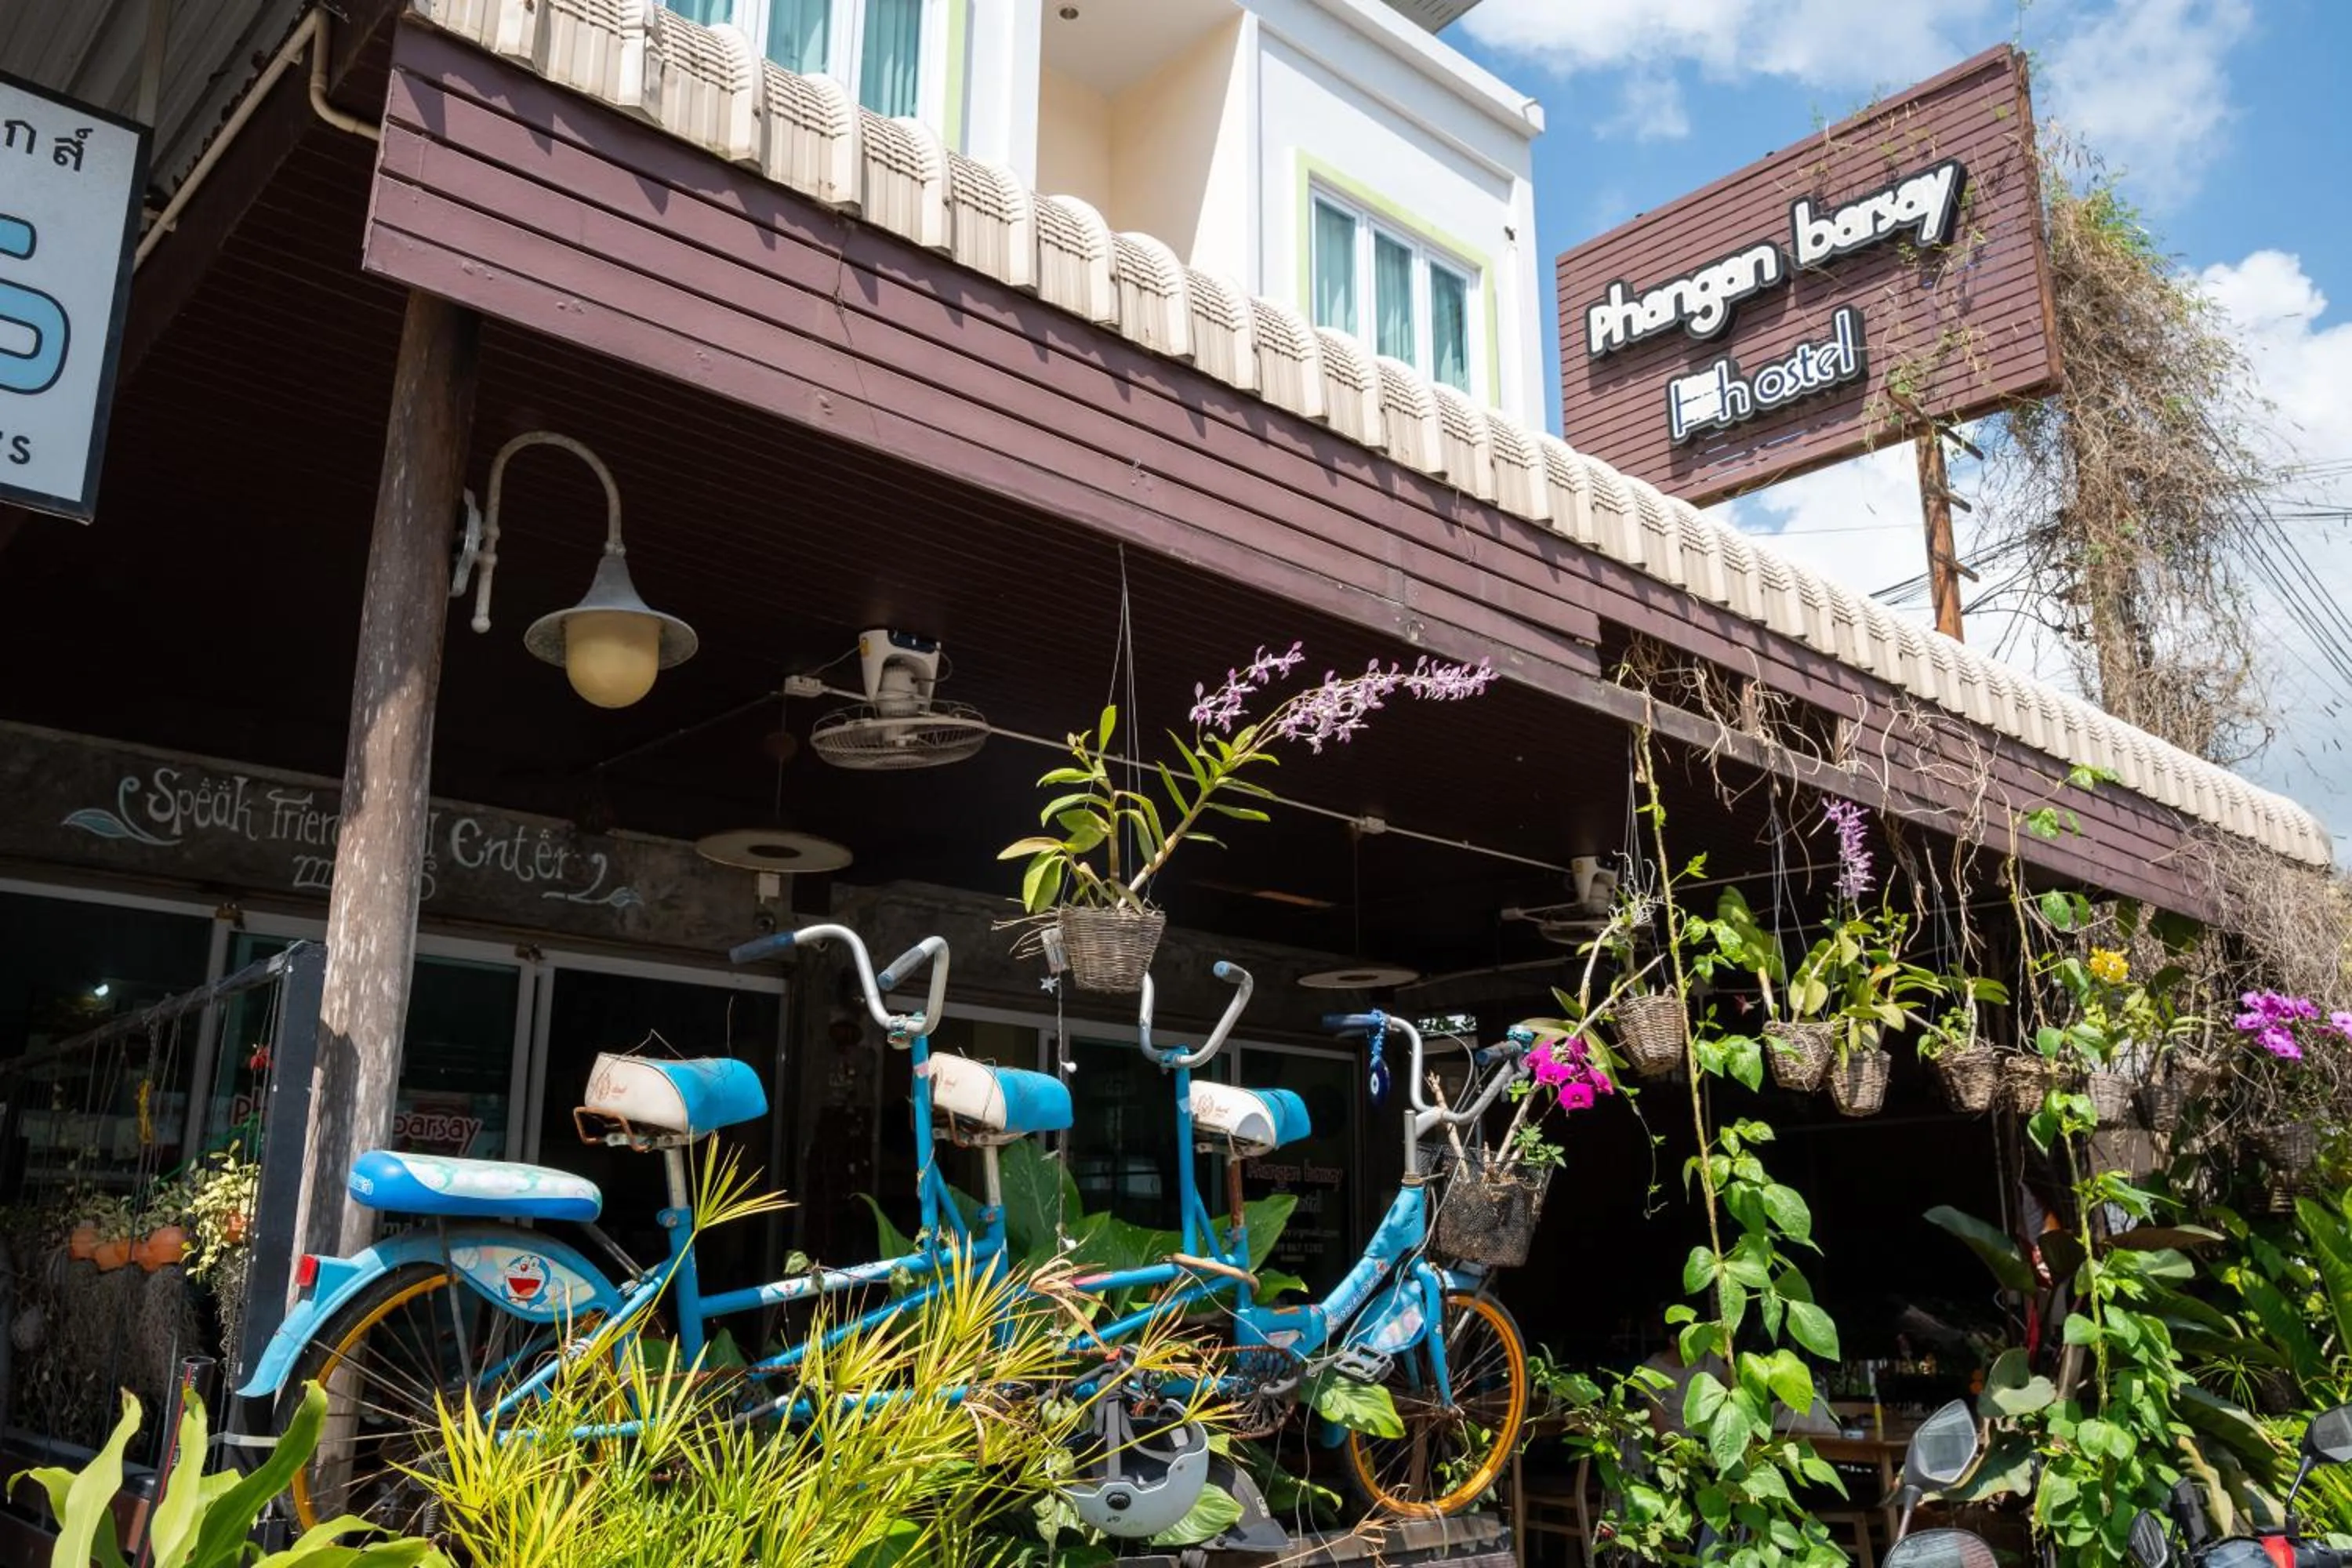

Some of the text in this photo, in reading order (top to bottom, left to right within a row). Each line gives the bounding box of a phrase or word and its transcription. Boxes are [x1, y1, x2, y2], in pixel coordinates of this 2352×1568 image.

[1794, 165, 1955, 265] barsay
[1715, 309, 1856, 422] hostel
[267, 788, 341, 846] Frien
